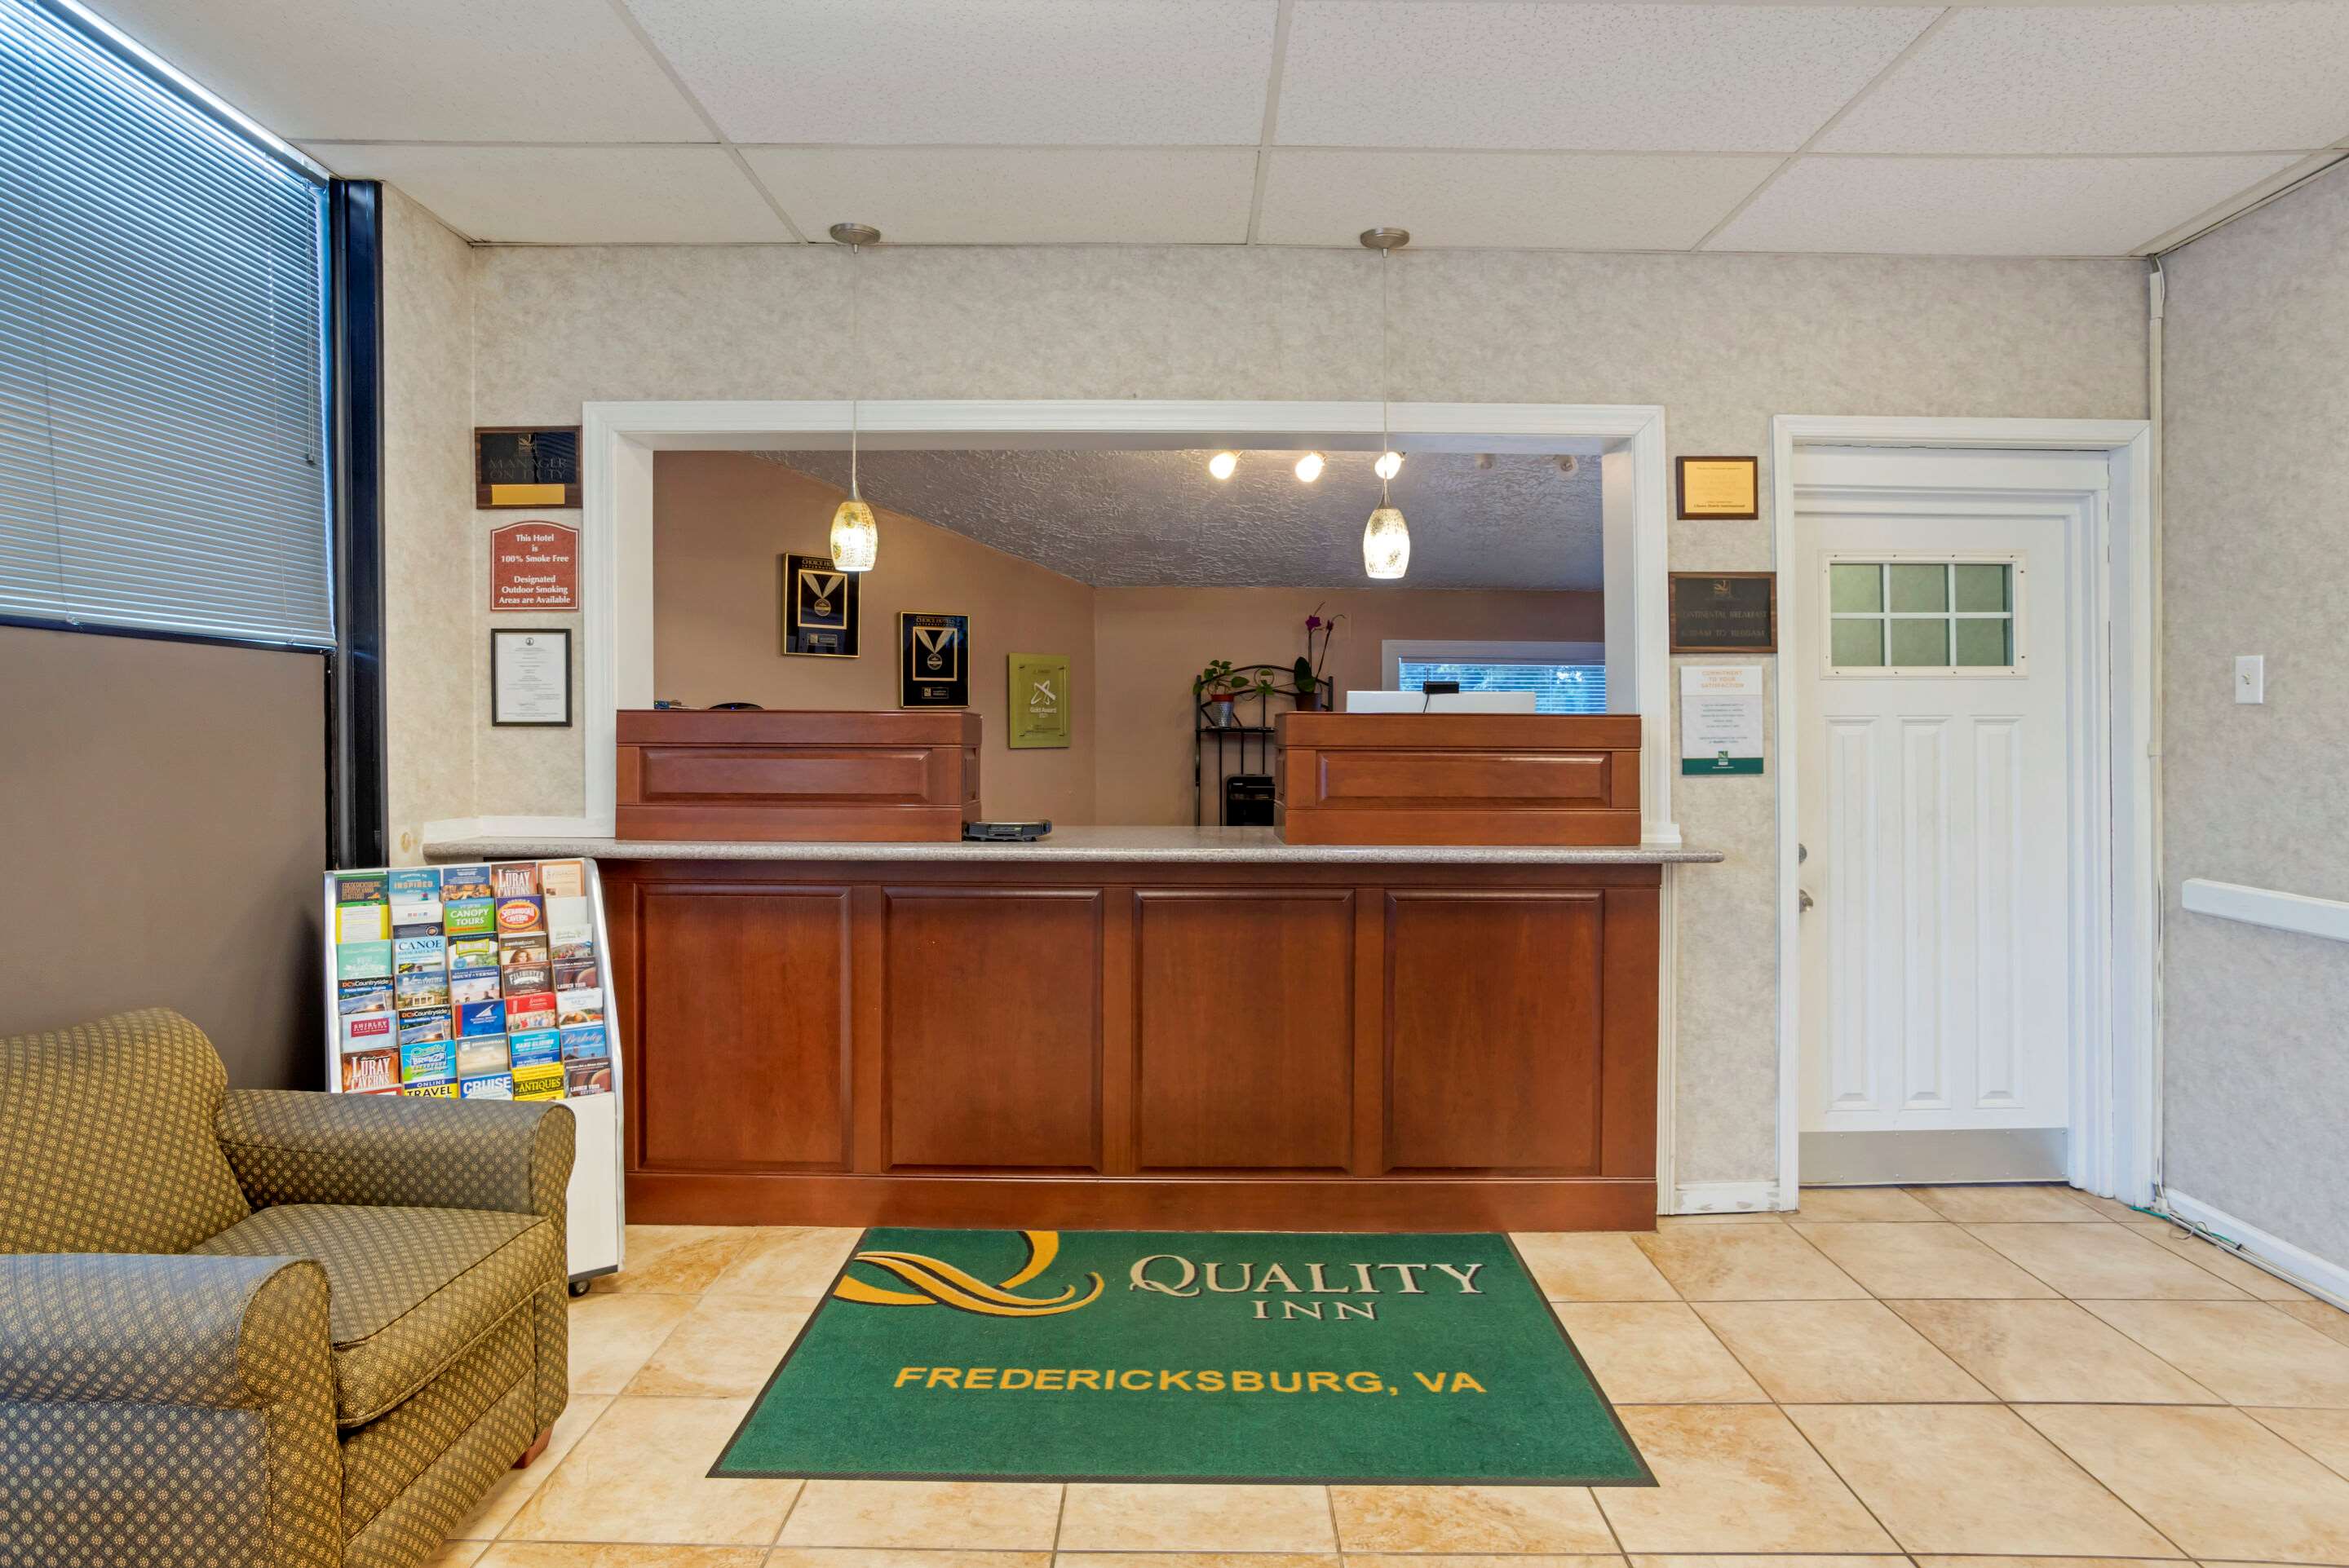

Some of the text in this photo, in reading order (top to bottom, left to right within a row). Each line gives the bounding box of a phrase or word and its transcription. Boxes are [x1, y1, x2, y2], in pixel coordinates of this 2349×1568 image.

[525, 554, 551, 563] Smoke
[514, 575, 555, 585] Designated
[536, 585, 568, 595] Smoking
[536, 596, 571, 604] Available
[498, 868, 531, 888] LURAY
[450, 908, 489, 919] CANOPY
[456, 917, 484, 926] TOURS
[399, 939, 443, 951] CANOE
[352, 1056, 392, 1078] LURAY
[351, 1073, 391, 1090] CAVERNS
[462, 1076, 512, 1095] CRUISE
[519, 1077, 562, 1093] ANTIQUES
[407, 1085, 452, 1098] TRAVEL
[1129, 1254, 1484, 1297] QUALITY
[1251, 1300, 1378, 1320] INN
[894, 1367, 1489, 1396] FREDERICKSBURG, VA
